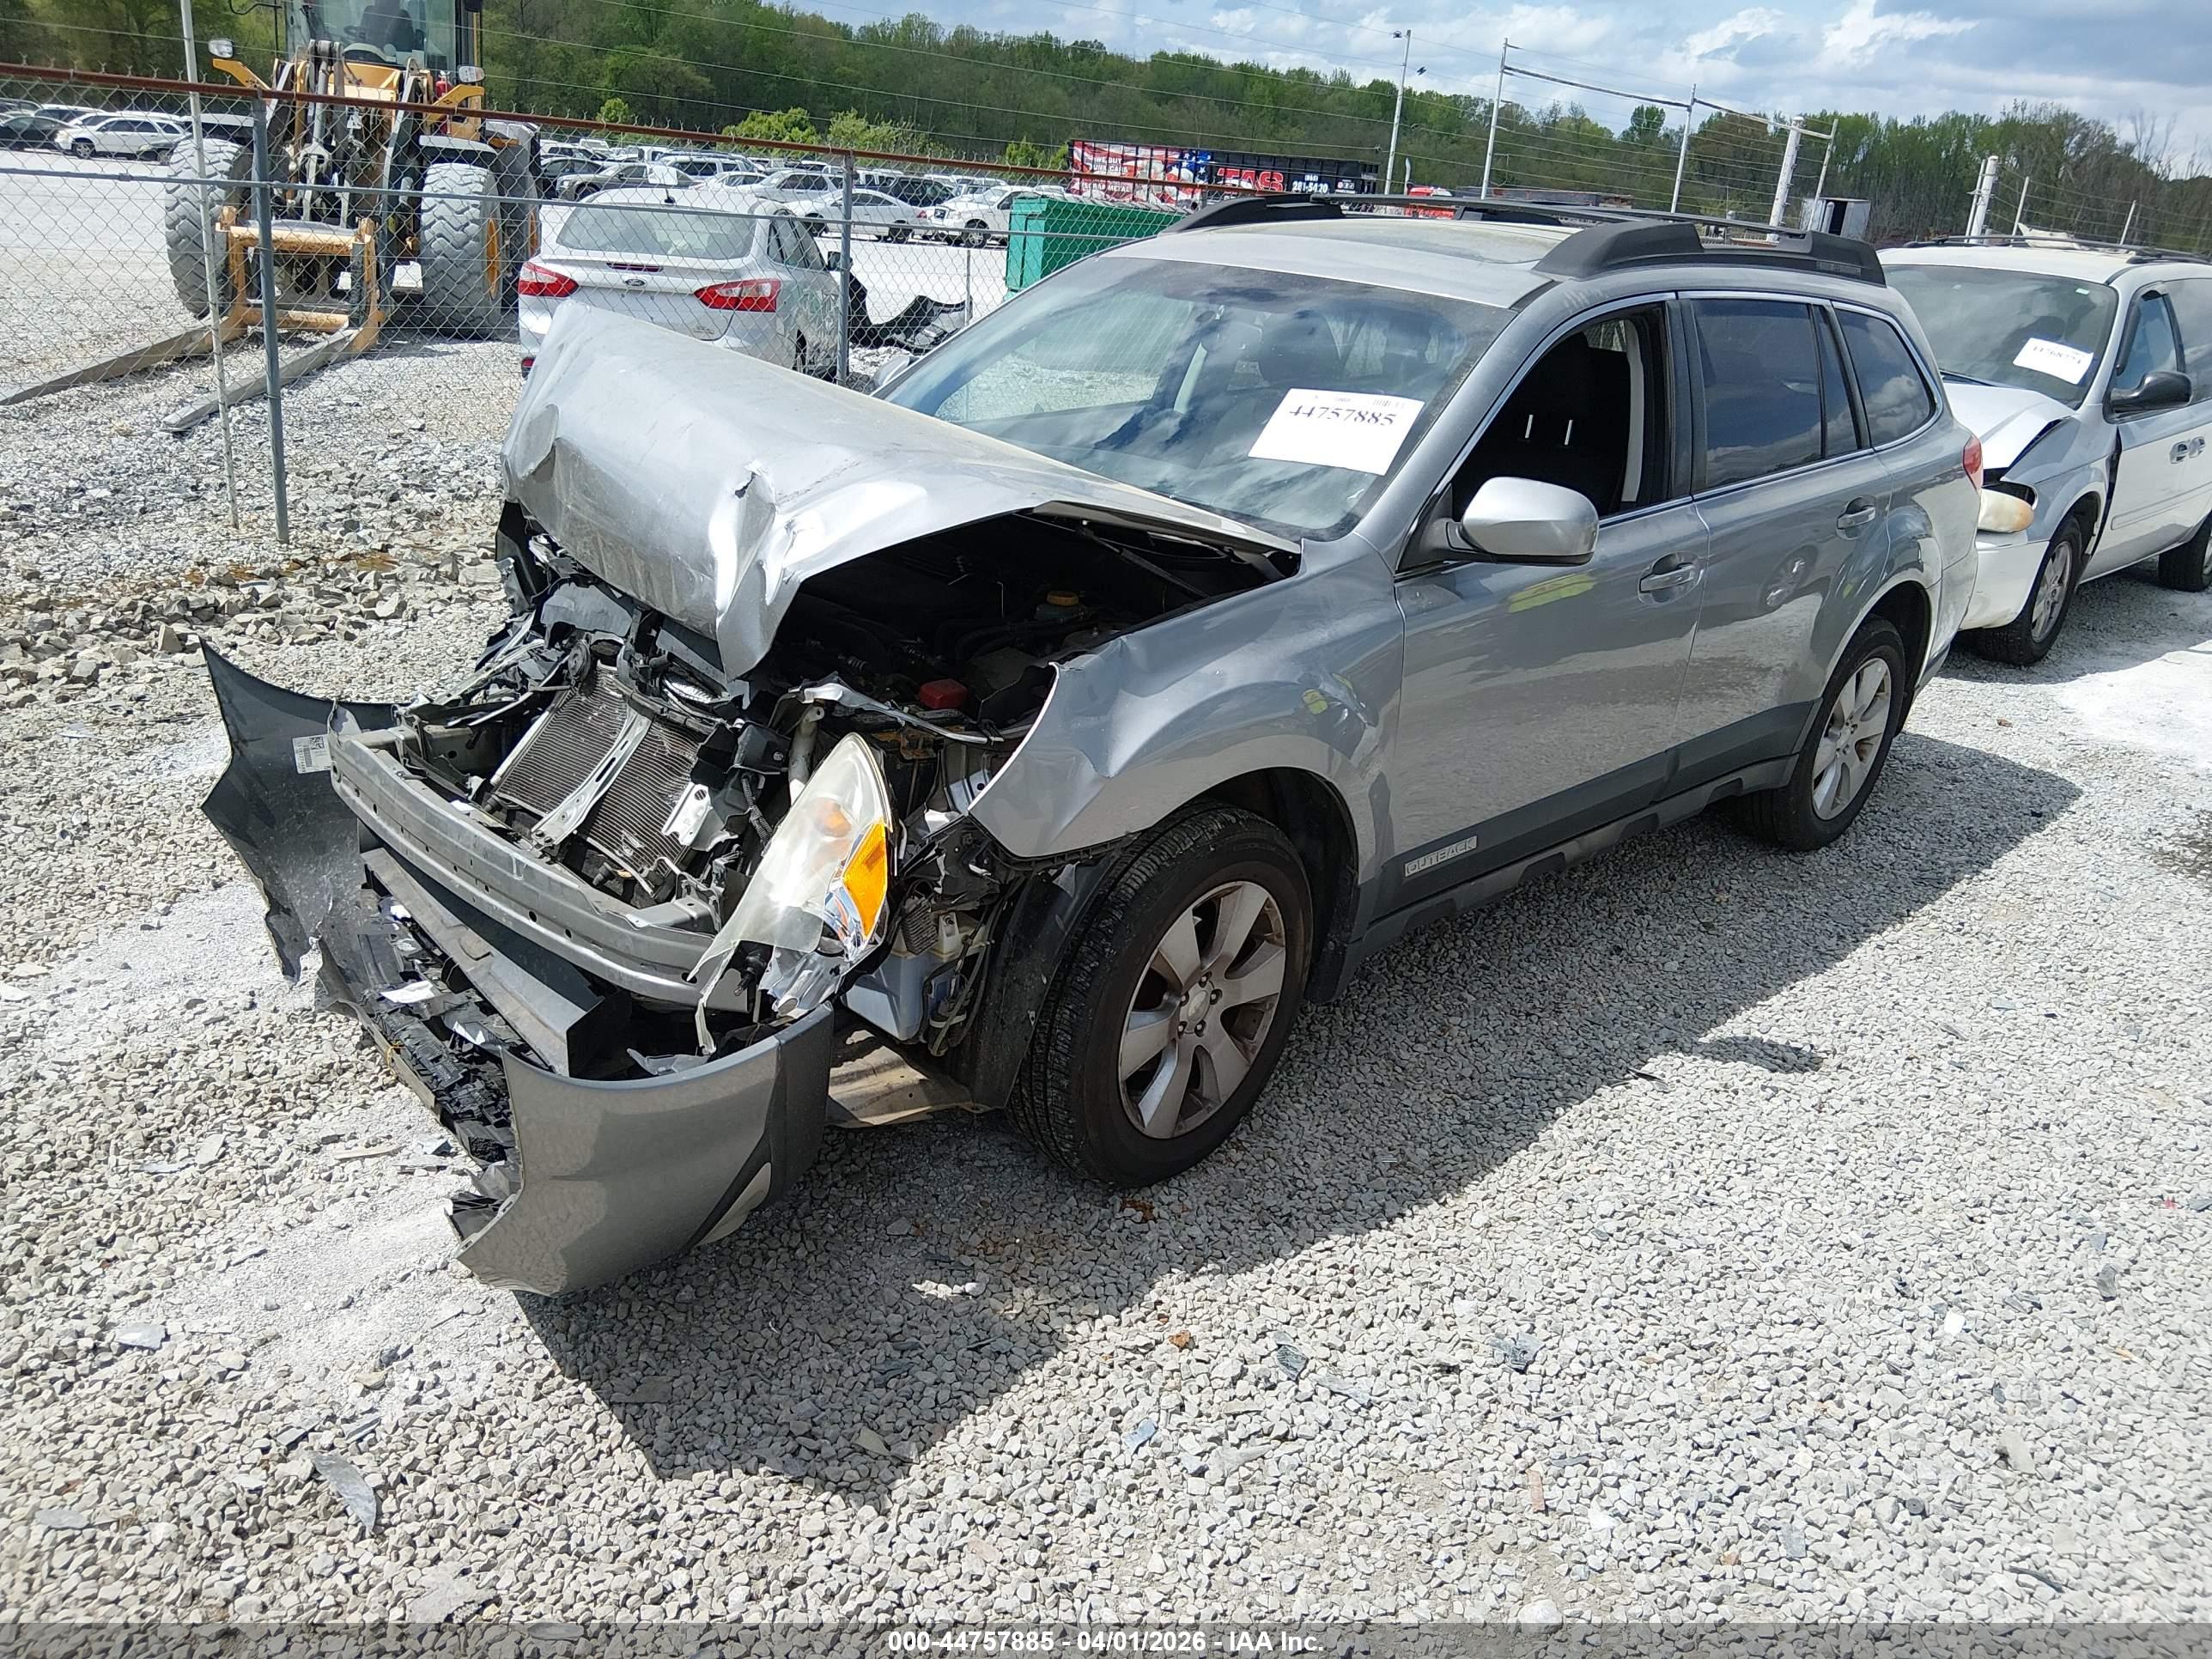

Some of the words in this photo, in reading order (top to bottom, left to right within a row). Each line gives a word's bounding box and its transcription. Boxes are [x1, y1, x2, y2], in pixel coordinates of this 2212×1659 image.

[1292, 180, 1328, 194] 281-5420
[1289, 404, 1397, 426] 44757885
[1406, 836, 1476, 875] OUTBACK
